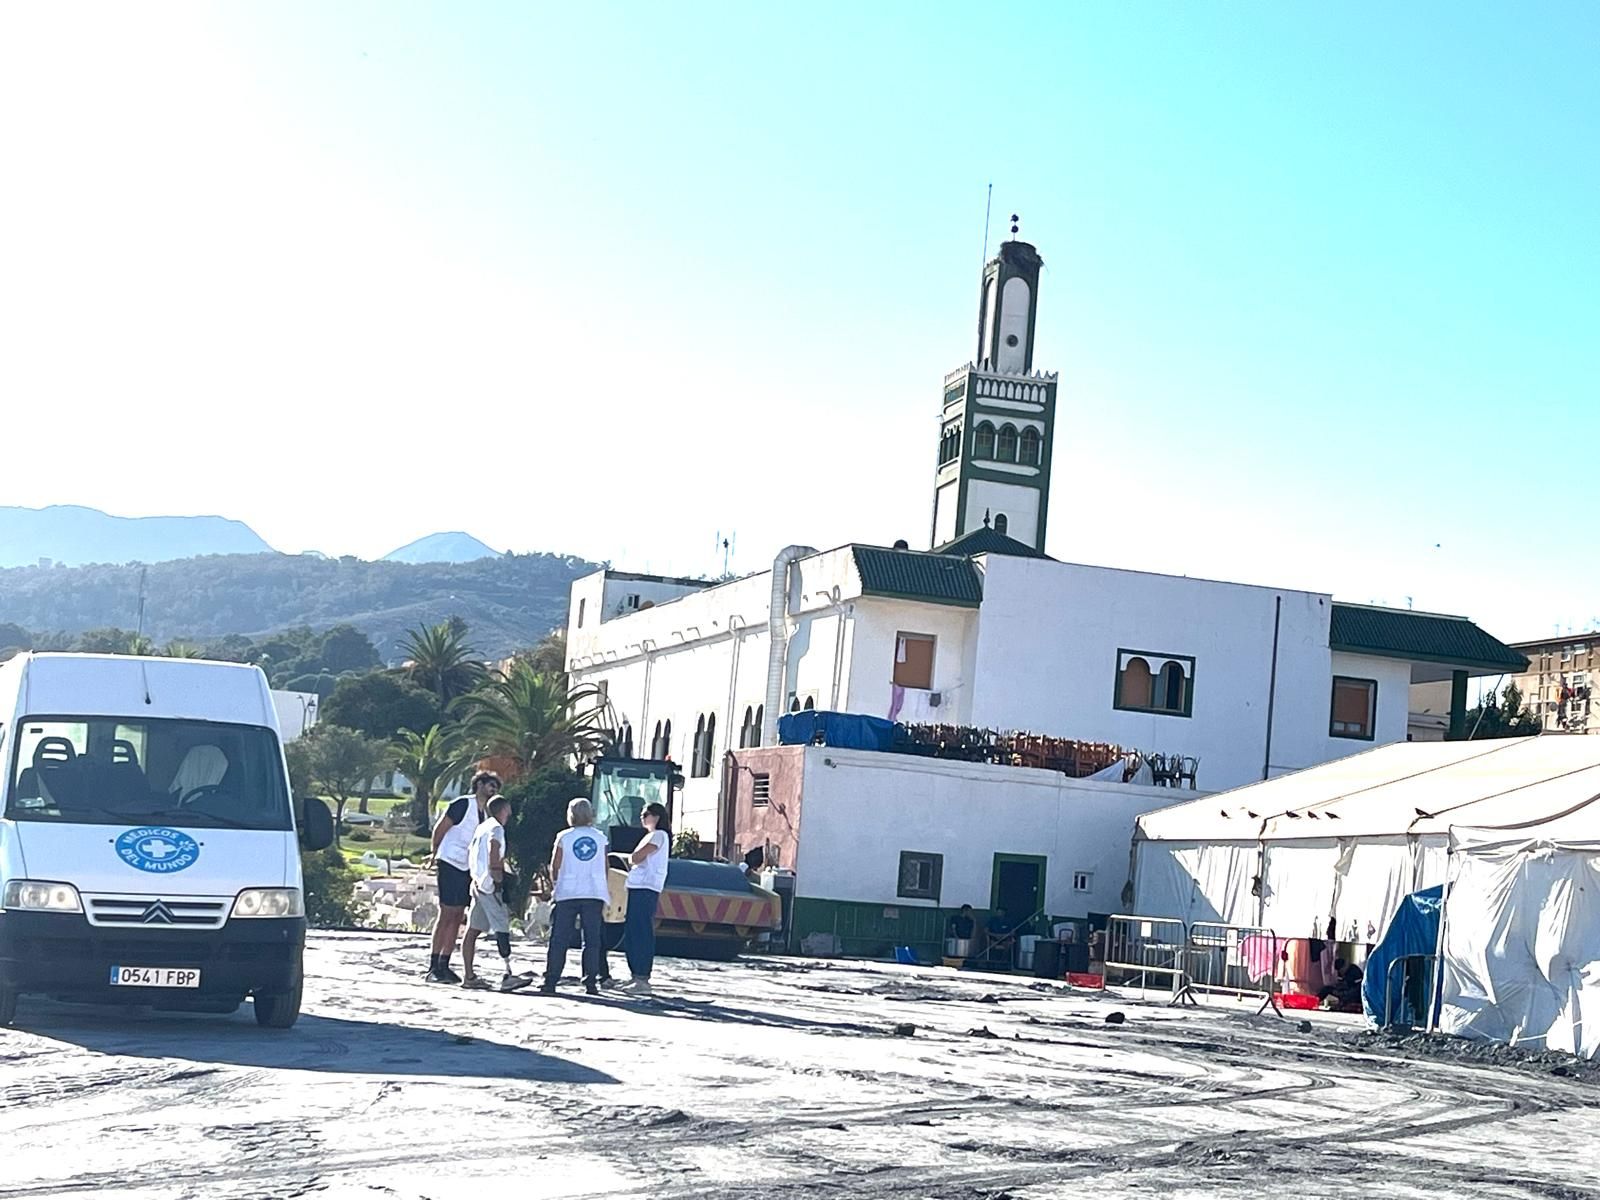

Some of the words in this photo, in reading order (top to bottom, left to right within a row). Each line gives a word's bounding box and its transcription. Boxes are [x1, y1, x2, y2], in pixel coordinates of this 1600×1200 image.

[121, 848, 141, 865] DEL
[144, 854, 192, 870] MUNDO
[121, 968, 160, 984] 0541
[166, 970, 196, 986] FBP
